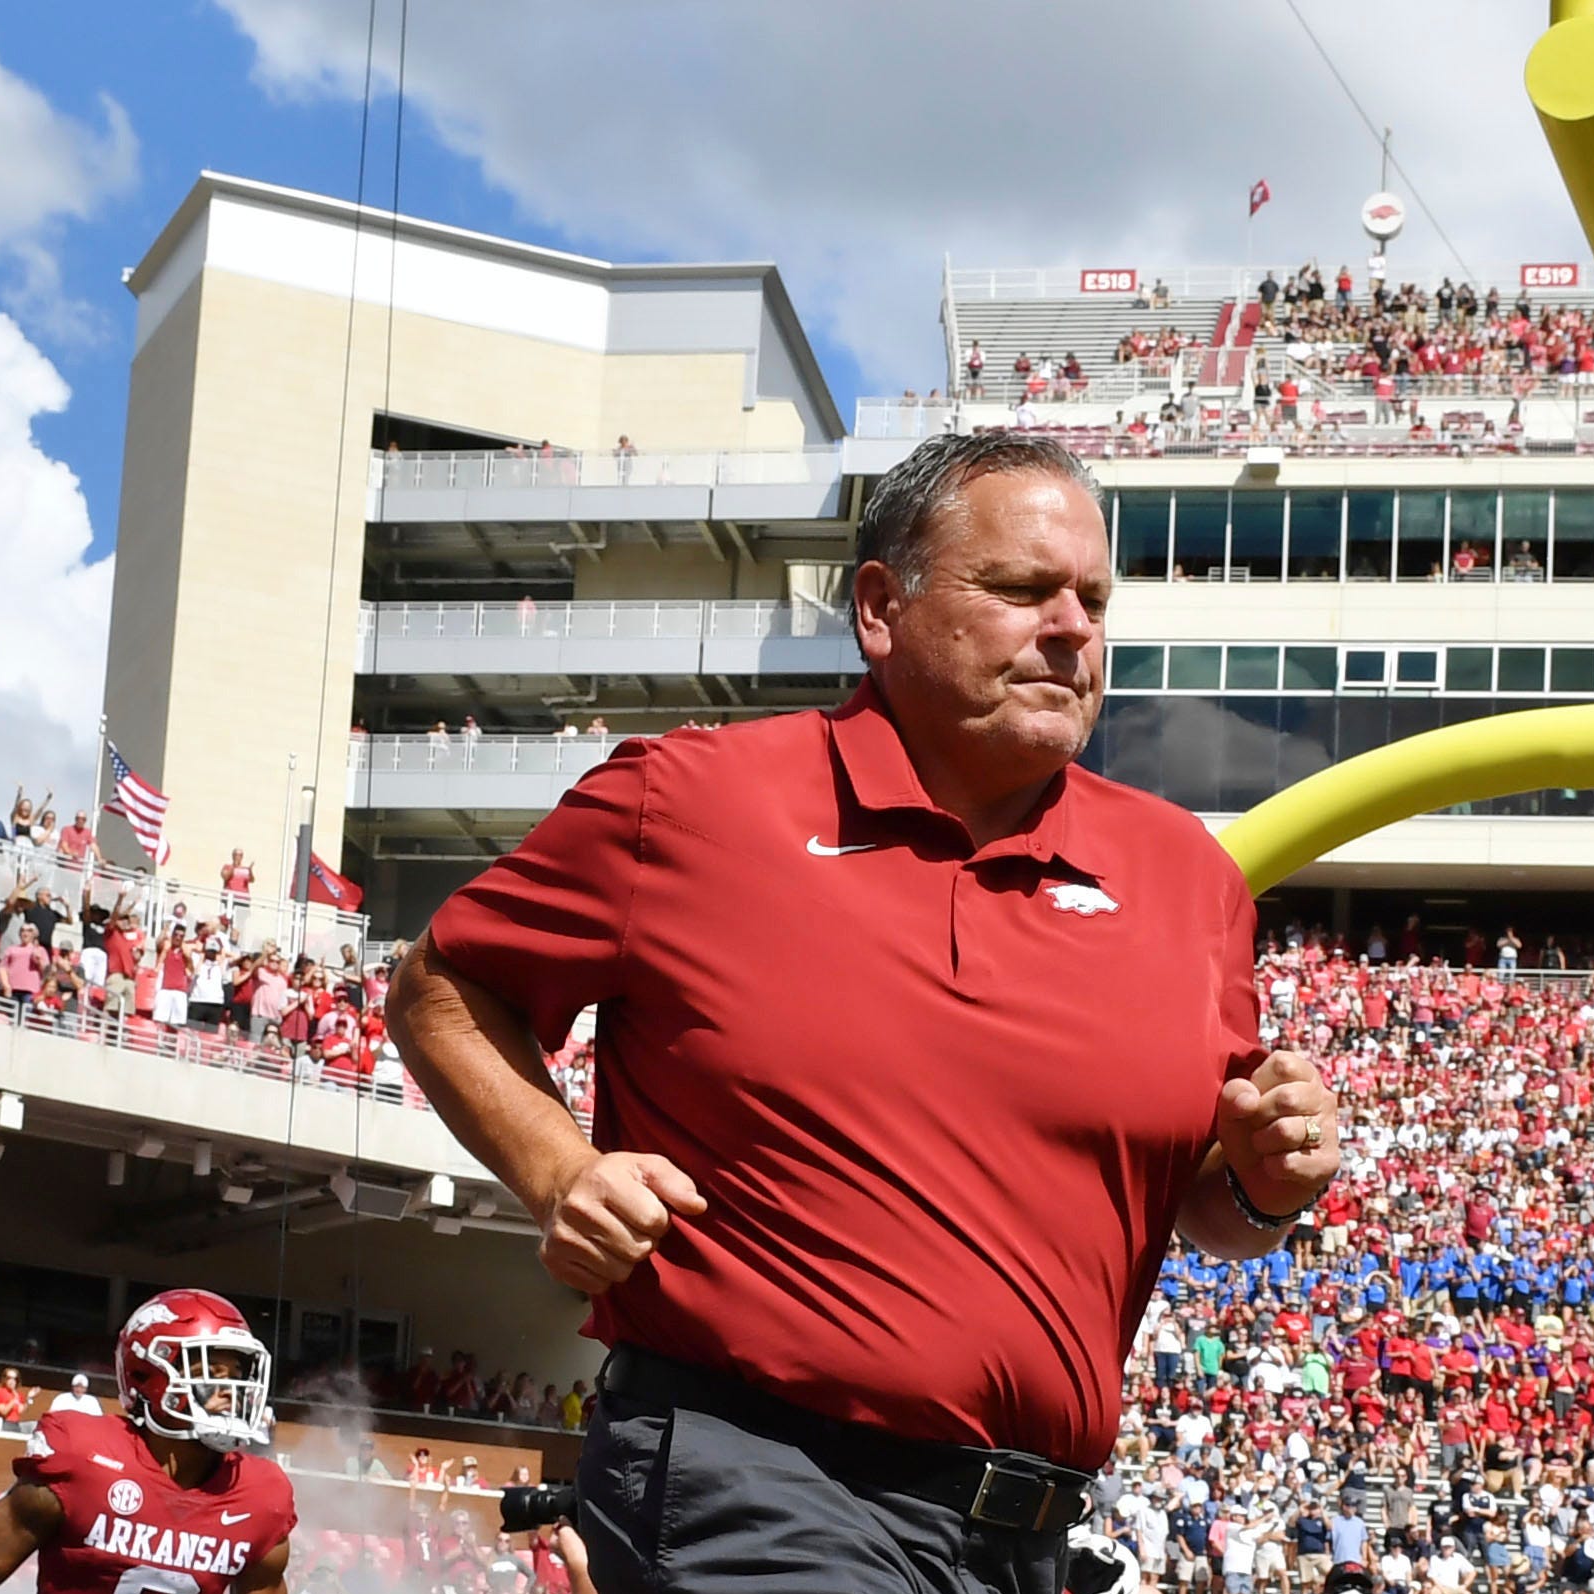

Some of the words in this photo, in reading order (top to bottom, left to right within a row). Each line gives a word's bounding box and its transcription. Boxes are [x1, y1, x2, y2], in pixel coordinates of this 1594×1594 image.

[1084, 272, 1132, 290] E518
[1525, 266, 1573, 285] E519
[109, 1482, 142, 1513] SEC
[83, 1512, 251, 1576] ARKANSAS
